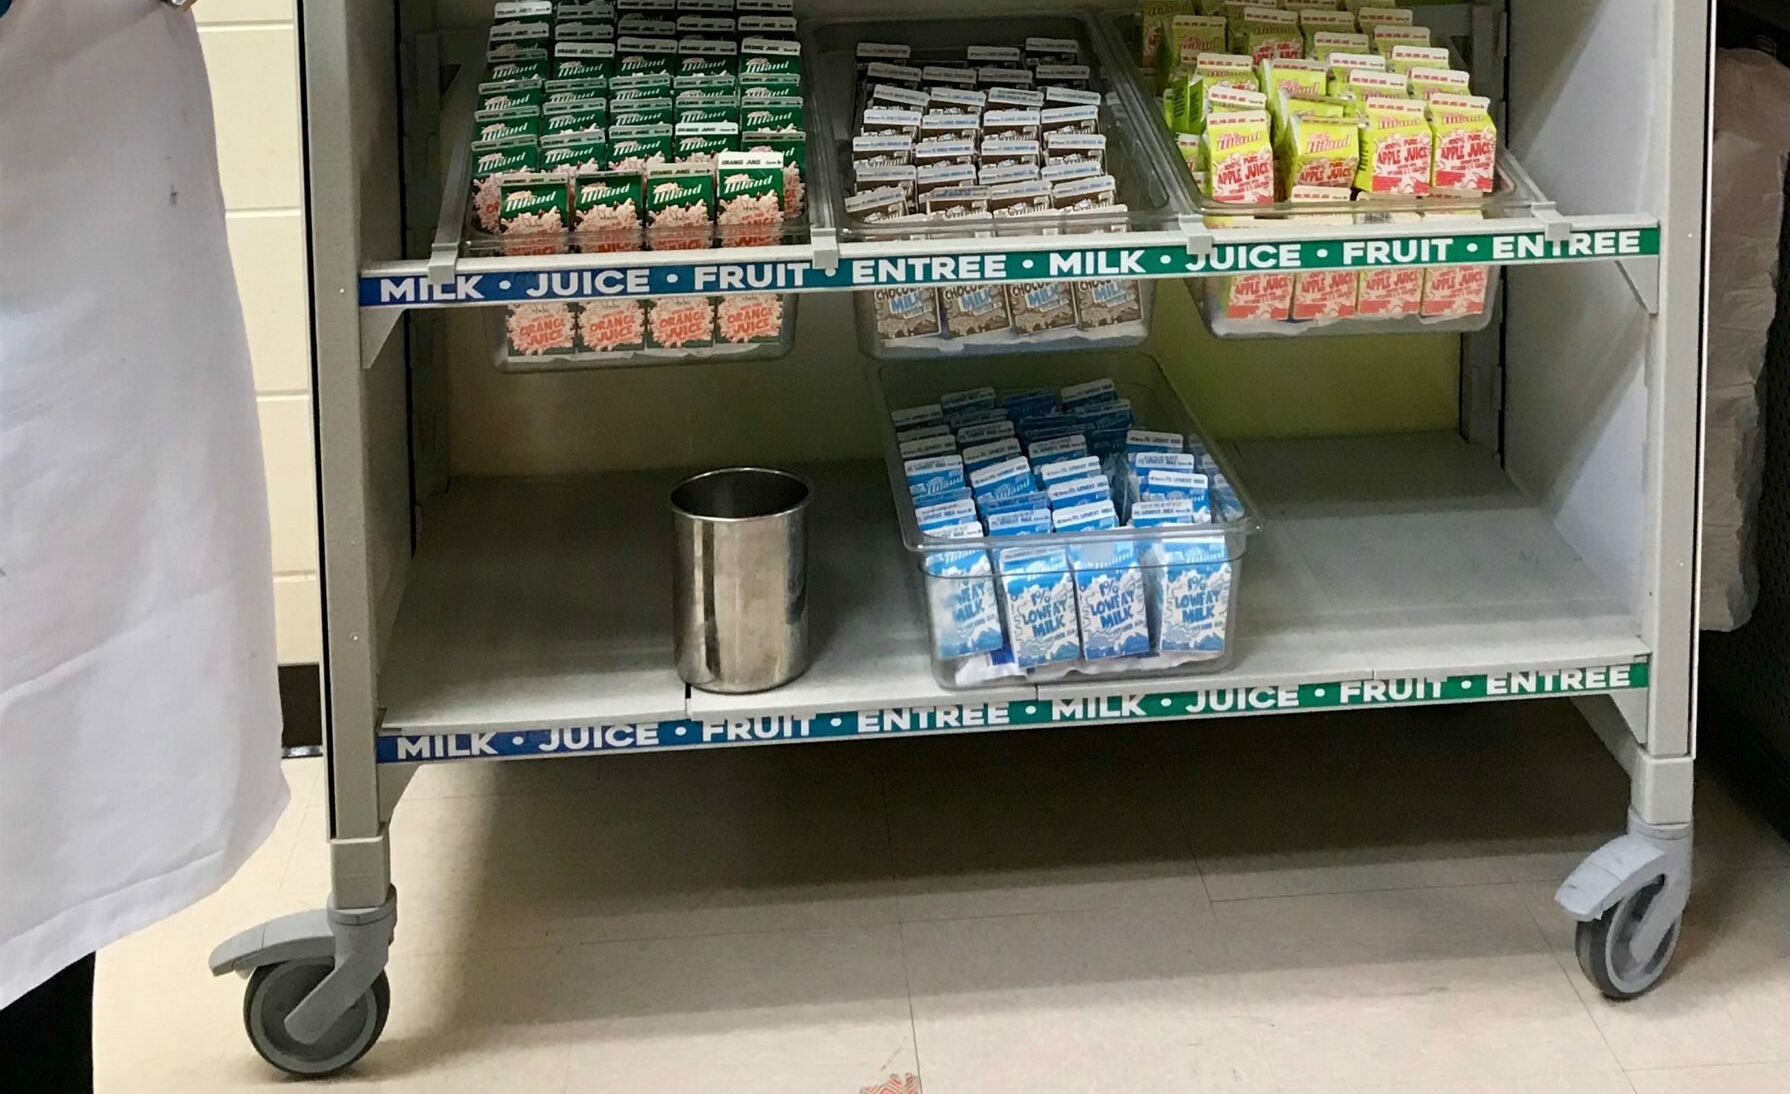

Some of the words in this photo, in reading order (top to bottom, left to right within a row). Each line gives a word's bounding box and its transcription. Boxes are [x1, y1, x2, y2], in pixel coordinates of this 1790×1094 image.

[746, 60, 789, 74] Hiland
[549, 114, 595, 130] Hiland
[747, 112, 792, 127] Hiland
[482, 122, 528, 141] Hiland
[612, 140, 661, 156] Hiland
[680, 138, 727, 152] Hiland
[1441, 145, 1465, 160] APPLE
[1468, 142, 1491, 157] JUICE
[478, 151, 526, 173] Hiland
[545, 147, 594, 164] Hiland
[1377, 149, 1401, 165] APPLE
[1404, 146, 1427, 163] JUICE
[1218, 168, 1242, 185] APPLE
[1245, 161, 1269, 180] JUICE
[1300, 168, 1324, 182] APPLE
[1327, 165, 1352, 179] JUICE
[581, 183, 631, 204] Hiland
[653, 184, 702, 205] Hiland
[724, 176, 773, 195] Hiland
[505, 191, 556, 212] Hiland
[380, 277, 484, 302] MILK
[525, 267, 650, 298] JUICE
[694, 262, 808, 292] FRUIT
[852, 253, 1007, 283] ENTREE
[1049, 250, 1146, 275] MILK
[1186, 243, 1301, 270] JUICE
[1342, 237, 1455, 265] FRUIT
[1492, 231, 1641, 258] ENTREE
[1235, 280, 1259, 295] APPLE
[1263, 276, 1288, 292] JUICE
[1302, 278, 1325, 293] APPLE
[1329, 273, 1353, 288] JUICE
[1366, 275, 1391, 290] APPLE
[1394, 271, 1418, 286] JUICE
[1431, 276, 1455, 290] APPLE
[1459, 270, 1483, 286] JUICE
[890, 290, 923, 311] MILK
[961, 288, 991, 309] MILK
[1027, 284, 1057, 305] MILK
[1094, 282, 1122, 302] MILK
[590, 314, 636, 332] ORANGE
[660, 311, 706, 327] ORANGE
[727, 307, 773, 324] ORANGE
[520, 318, 566, 336] ORANGE
[598, 325, 633, 342] JUICE
[666, 322, 702, 338] JUICE
[734, 318, 769, 334] JUICE
[527, 329, 563, 345] JUICE
[1099, 579, 1119, 597] 1%
[1187, 575, 1206, 591] 1%
[1031, 590, 1051, 606] 1%
[1090, 590, 1134, 616] LOWFAT
[1175, 590, 1220, 609] LOWFAT
[1023, 599, 1067, 625] LOWFAT
[1100, 606, 1133, 629] MILK
[1182, 605, 1215, 623] MILK
[1032, 615, 1065, 637] MILK
[398, 735, 498, 760] MILK
[538, 724, 660, 752] JUICE
[702, 716, 815, 743] FRUIT
[856, 704, 1010, 732] ENTREE
[1051, 693, 1147, 721] MILK
[1185, 686, 1300, 713] JUICE
[1339, 678, 1449, 705] FRUIT
[1486, 666, 1632, 696] ENTREE
